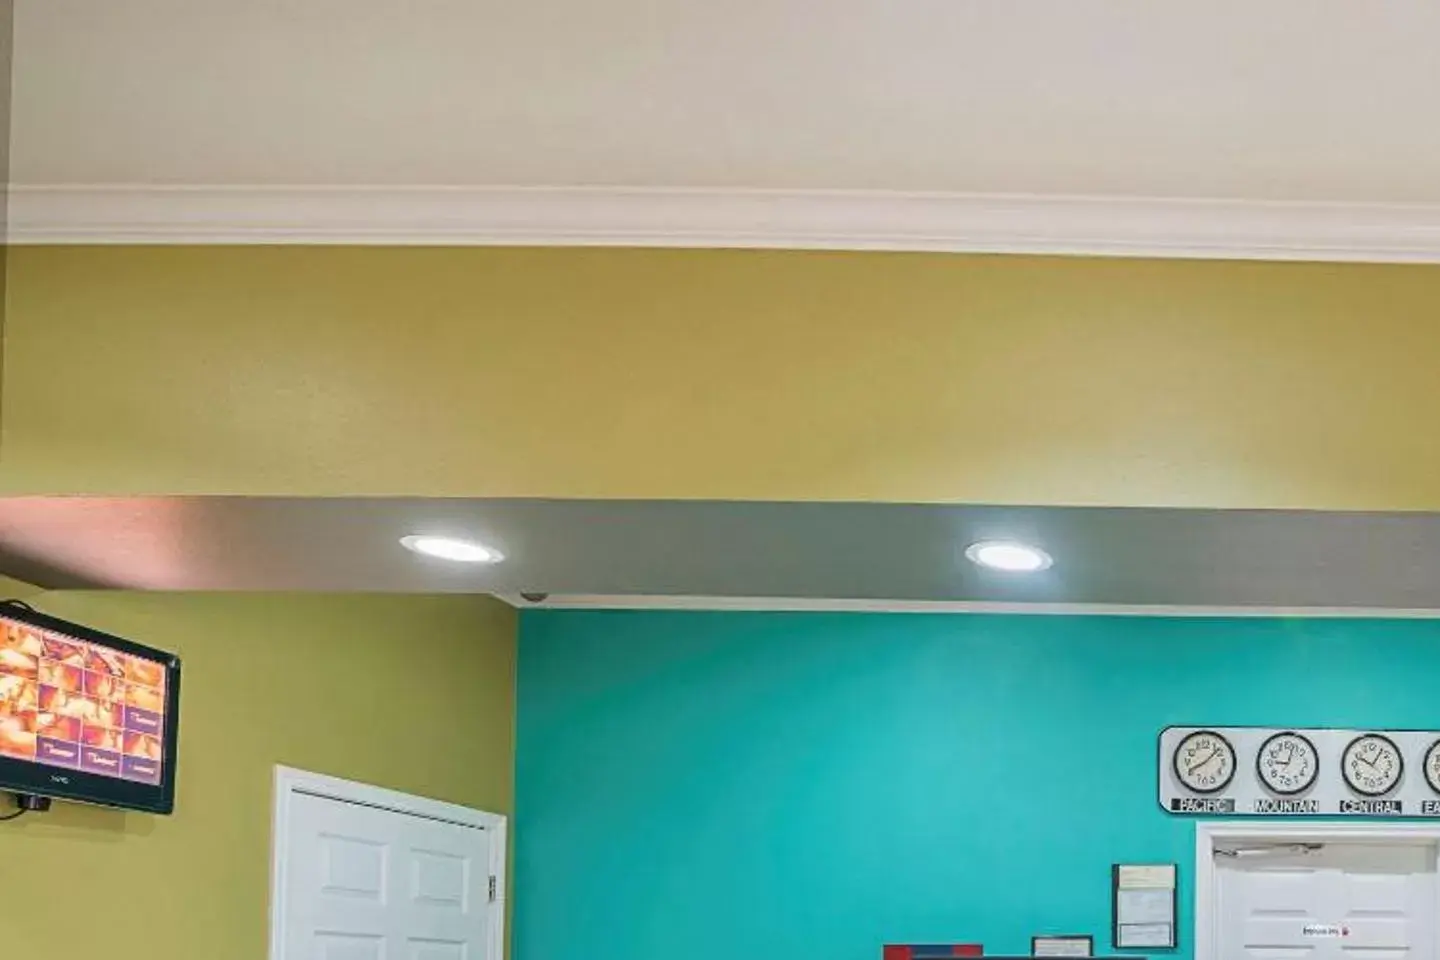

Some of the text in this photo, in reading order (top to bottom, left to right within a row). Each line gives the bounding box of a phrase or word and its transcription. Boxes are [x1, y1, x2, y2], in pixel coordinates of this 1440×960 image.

[1180, 799, 1226, 812] PACIFIC
[1255, 799, 1319, 813] MOUNTAIN
[1342, 800, 1398, 813] CENTRAL
